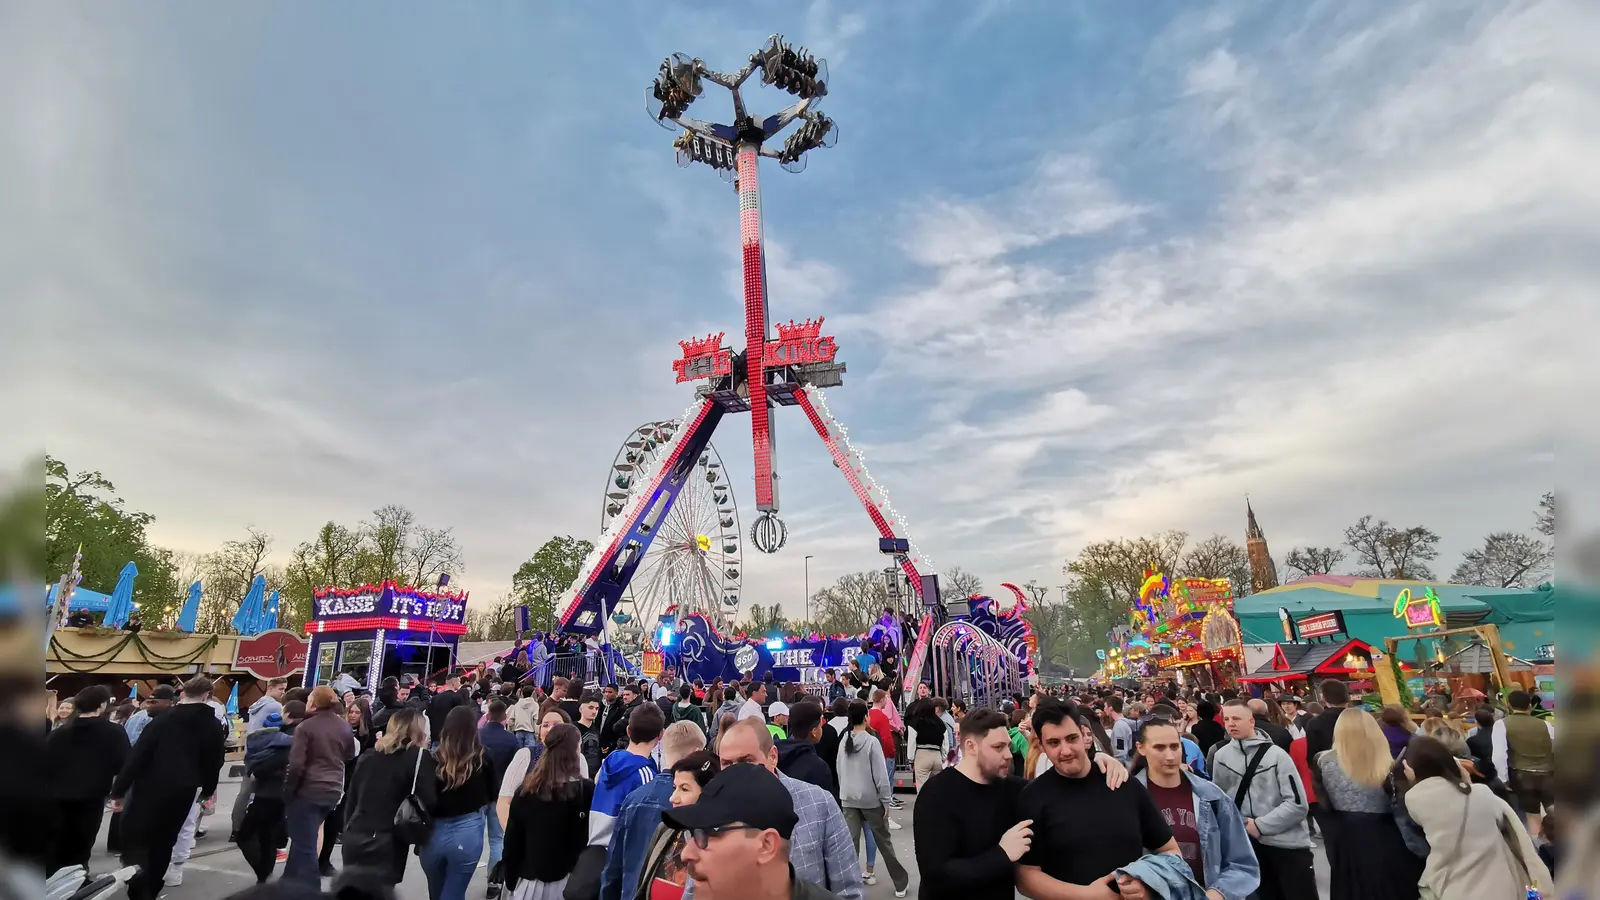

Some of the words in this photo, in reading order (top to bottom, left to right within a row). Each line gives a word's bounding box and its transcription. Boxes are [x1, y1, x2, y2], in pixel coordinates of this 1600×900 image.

[672, 351, 731, 384] THE
[762, 336, 836, 367] KING
[318, 596, 375, 616] KASSE
[770, 649, 813, 665] THE
